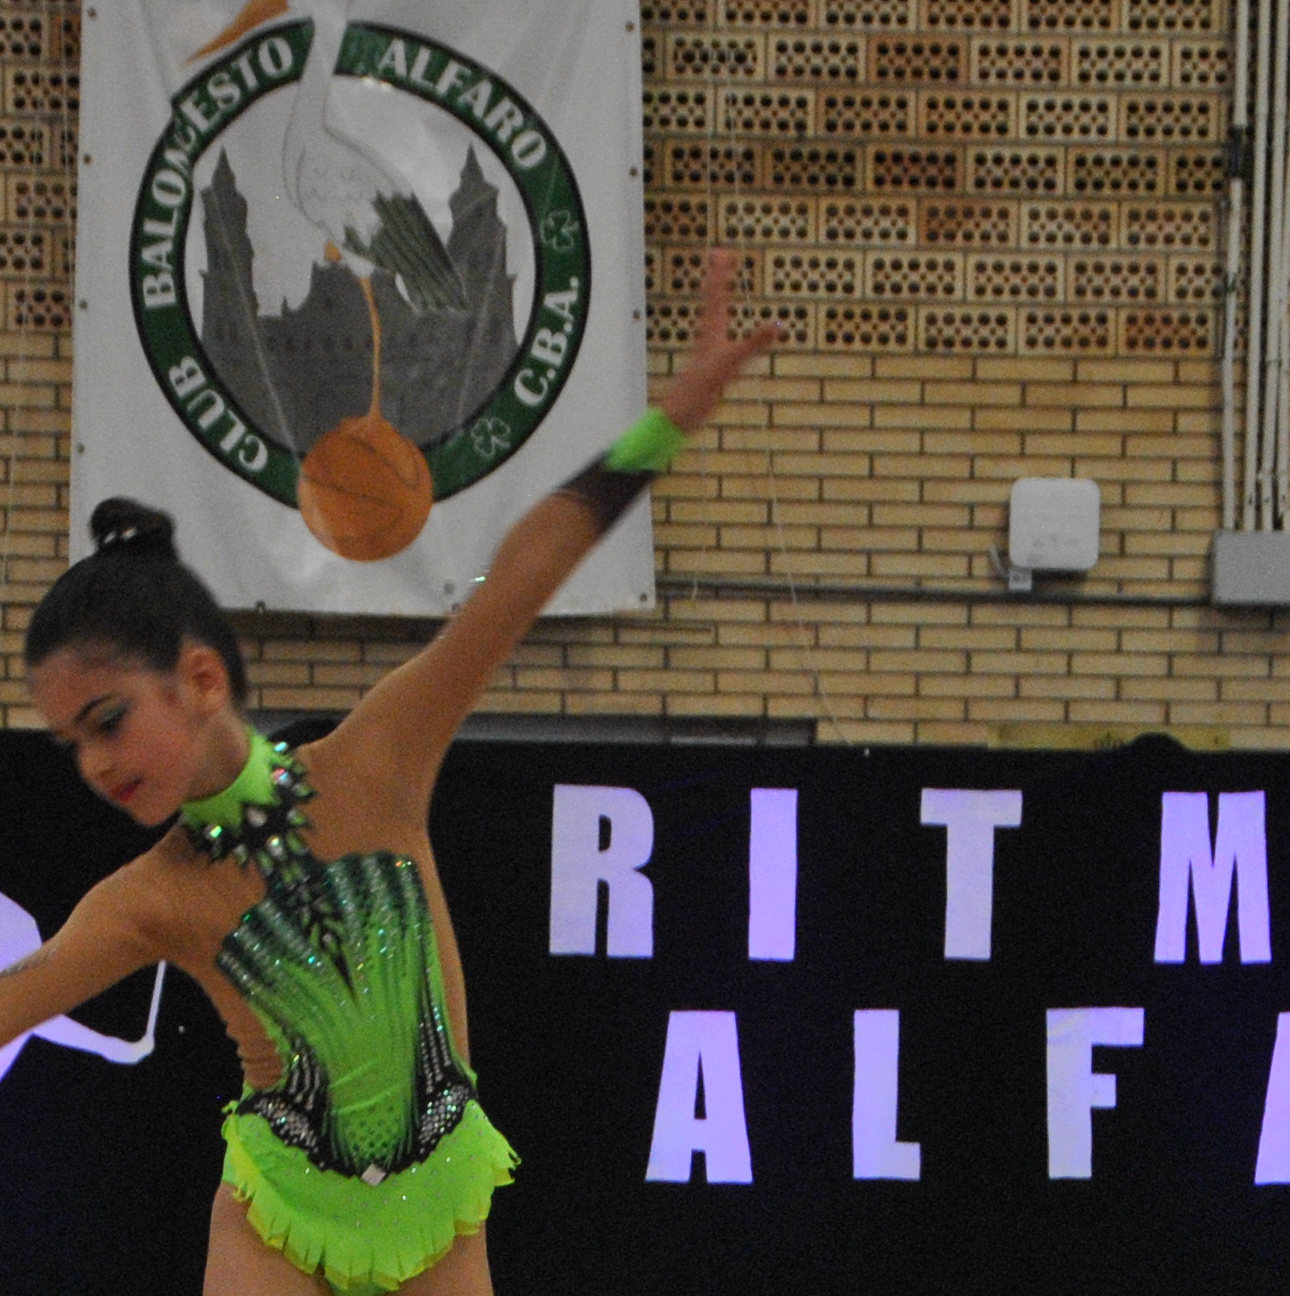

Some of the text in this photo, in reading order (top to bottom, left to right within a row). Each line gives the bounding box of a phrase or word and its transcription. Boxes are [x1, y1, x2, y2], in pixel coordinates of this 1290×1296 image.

[168, 356, 268, 473] CLUB
[377, 39, 548, 169] ALFARO
[513, 276, 579, 406] C.B.A.
